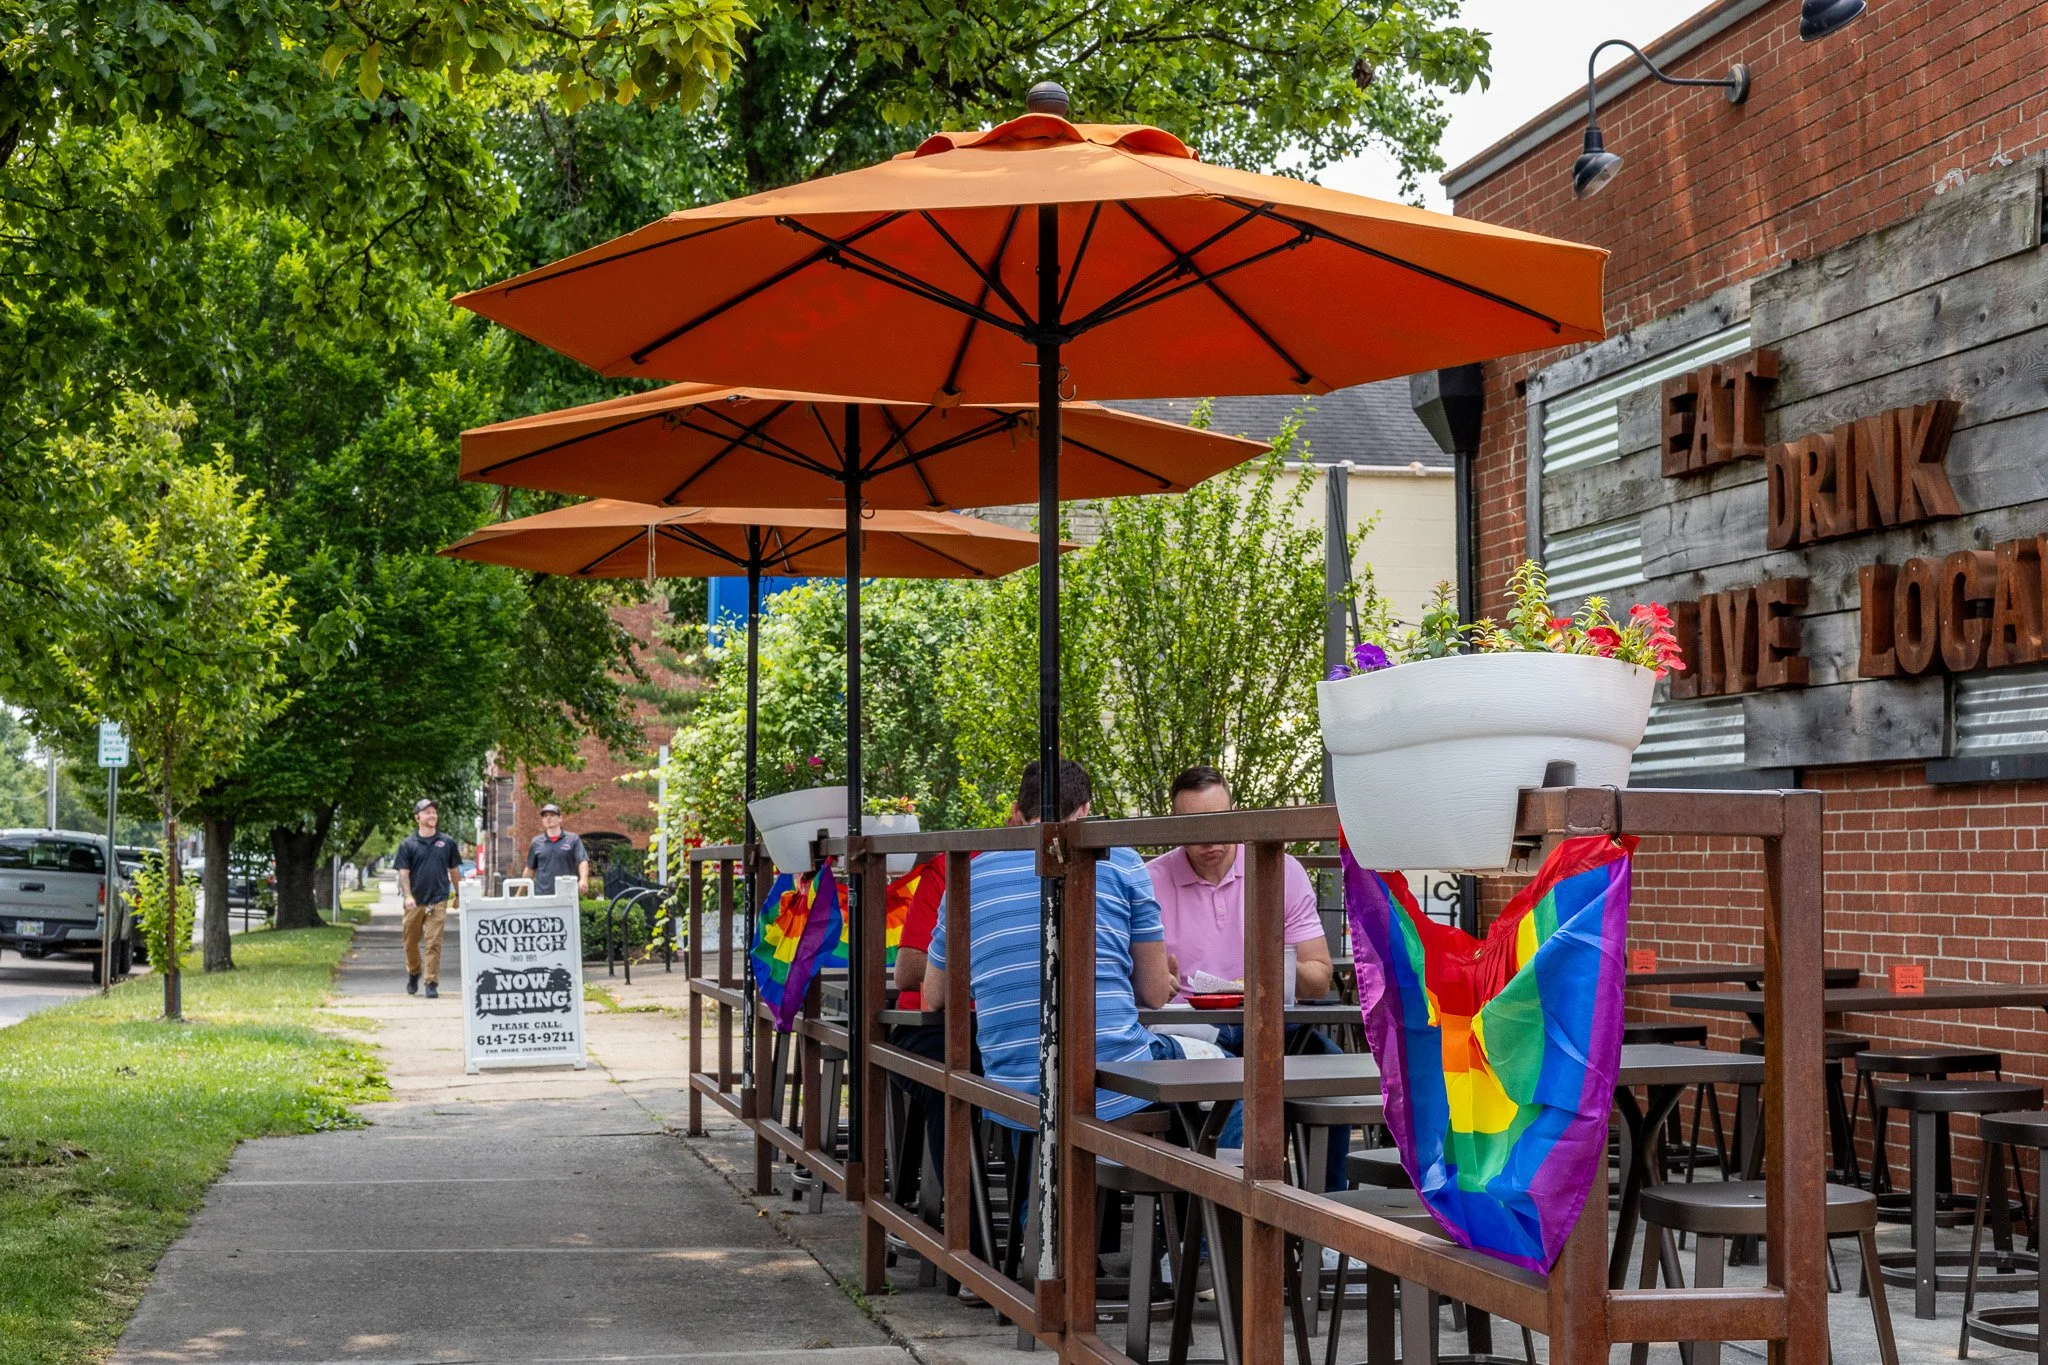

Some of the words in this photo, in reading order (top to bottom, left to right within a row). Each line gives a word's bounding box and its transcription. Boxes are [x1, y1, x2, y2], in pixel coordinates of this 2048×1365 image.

[1661, 348, 1779, 478] EAT
[1766, 400, 1961, 551] DRINK
[1667, 578, 1810, 700] LIVE
[478, 917, 565, 936] SMOKED
[478, 936, 508, 954] ON
[513, 934, 567, 952] HIGH
[495, 973, 550, 991] NOW
[480, 991, 568, 1010] HIRING
[491, 1022, 529, 1031] PLEASE
[534, 1021, 563, 1029] CALL:
[477, 1031, 575, 1046] 614-754-9711
